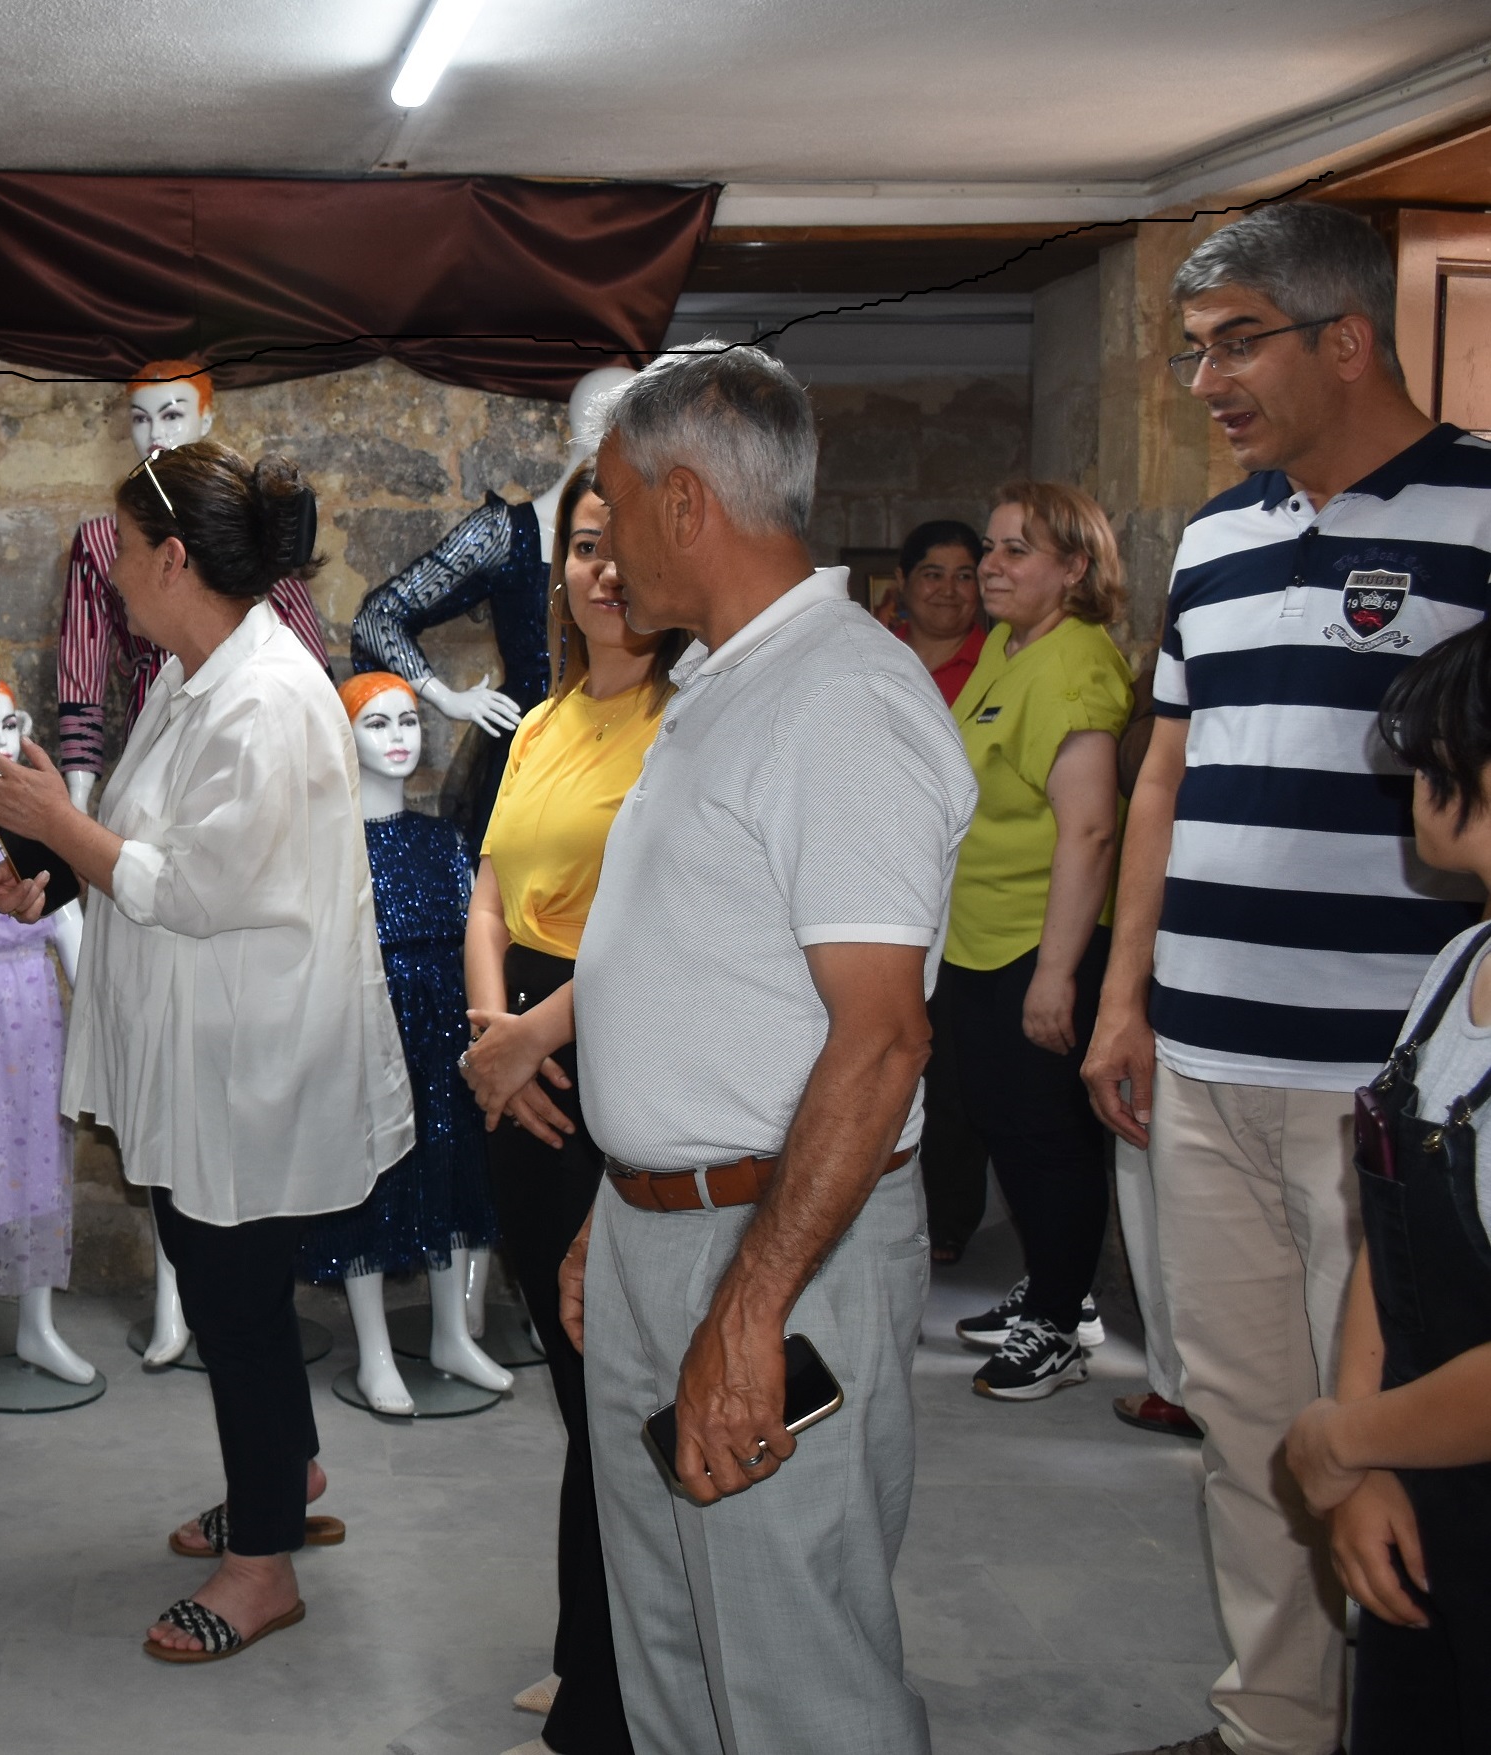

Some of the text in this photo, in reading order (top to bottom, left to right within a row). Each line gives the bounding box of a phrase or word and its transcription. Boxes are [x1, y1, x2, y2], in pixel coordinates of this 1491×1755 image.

[1355, 574, 1405, 586] RUGBY
[1346, 598, 1398, 611] 19 88
